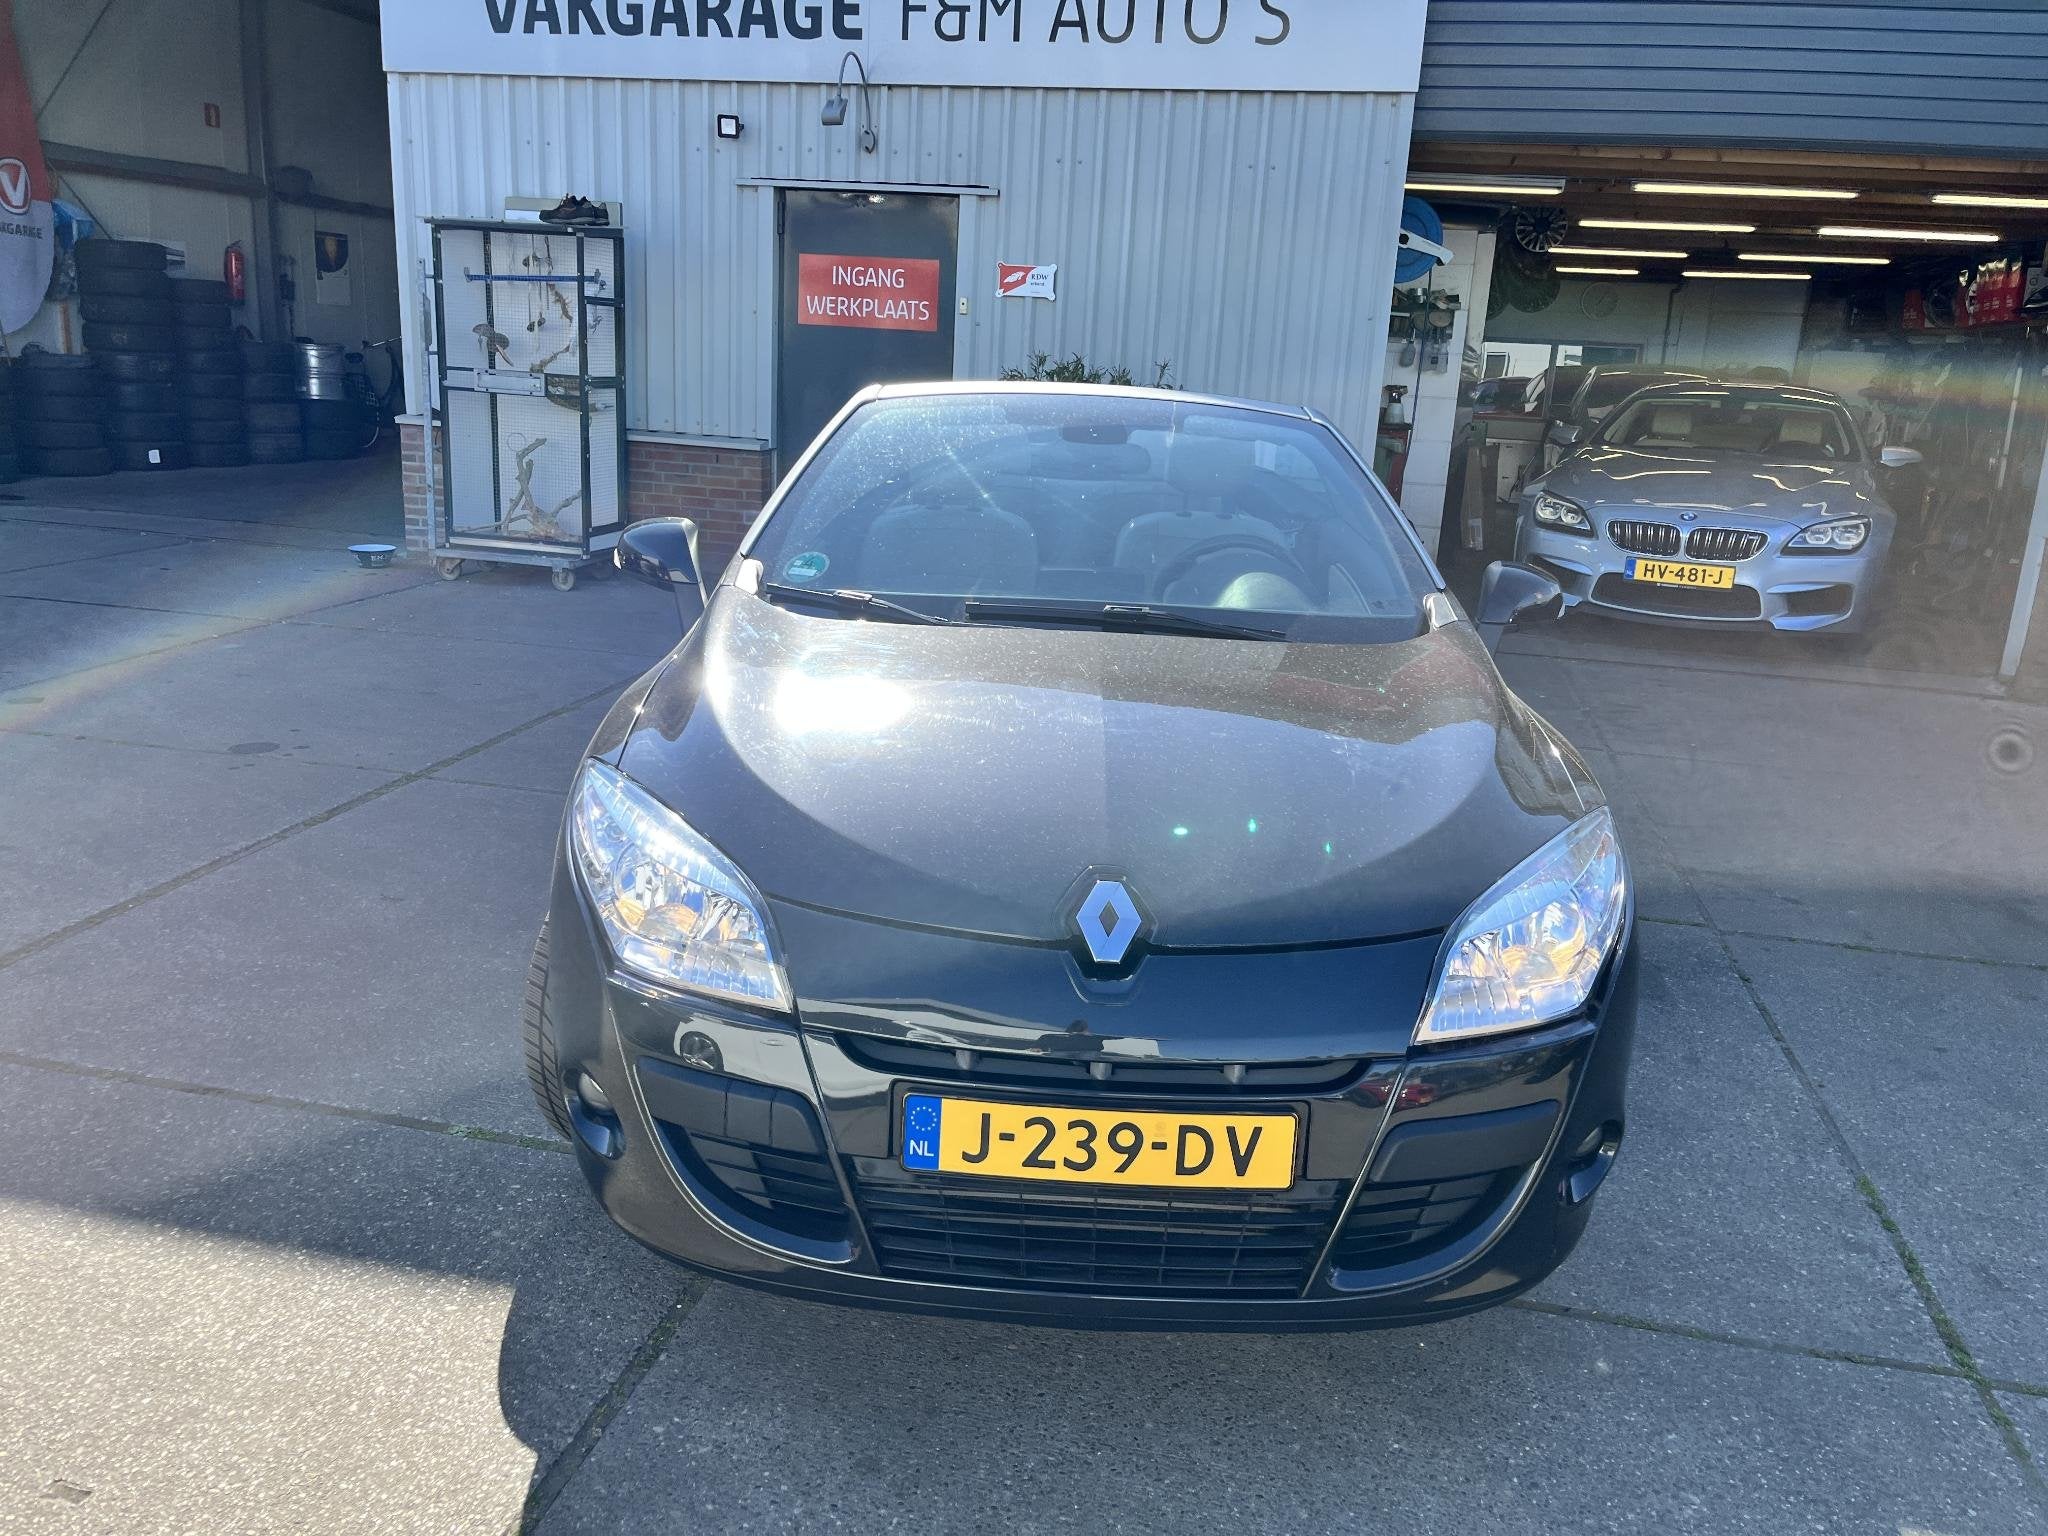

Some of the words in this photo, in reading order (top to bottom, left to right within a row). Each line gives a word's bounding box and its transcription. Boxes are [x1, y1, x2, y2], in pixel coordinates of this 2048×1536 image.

[901, 0, 1020, 42] F&M
[832, 265, 905, 288] INGANG
[806, 295, 930, 321] WERKPLAATS
[1643, 563, 1723, 584] HV-481-J
[909, 1139, 934, 1157] NL
[961, 1112, 1263, 1177] J-239-DV
